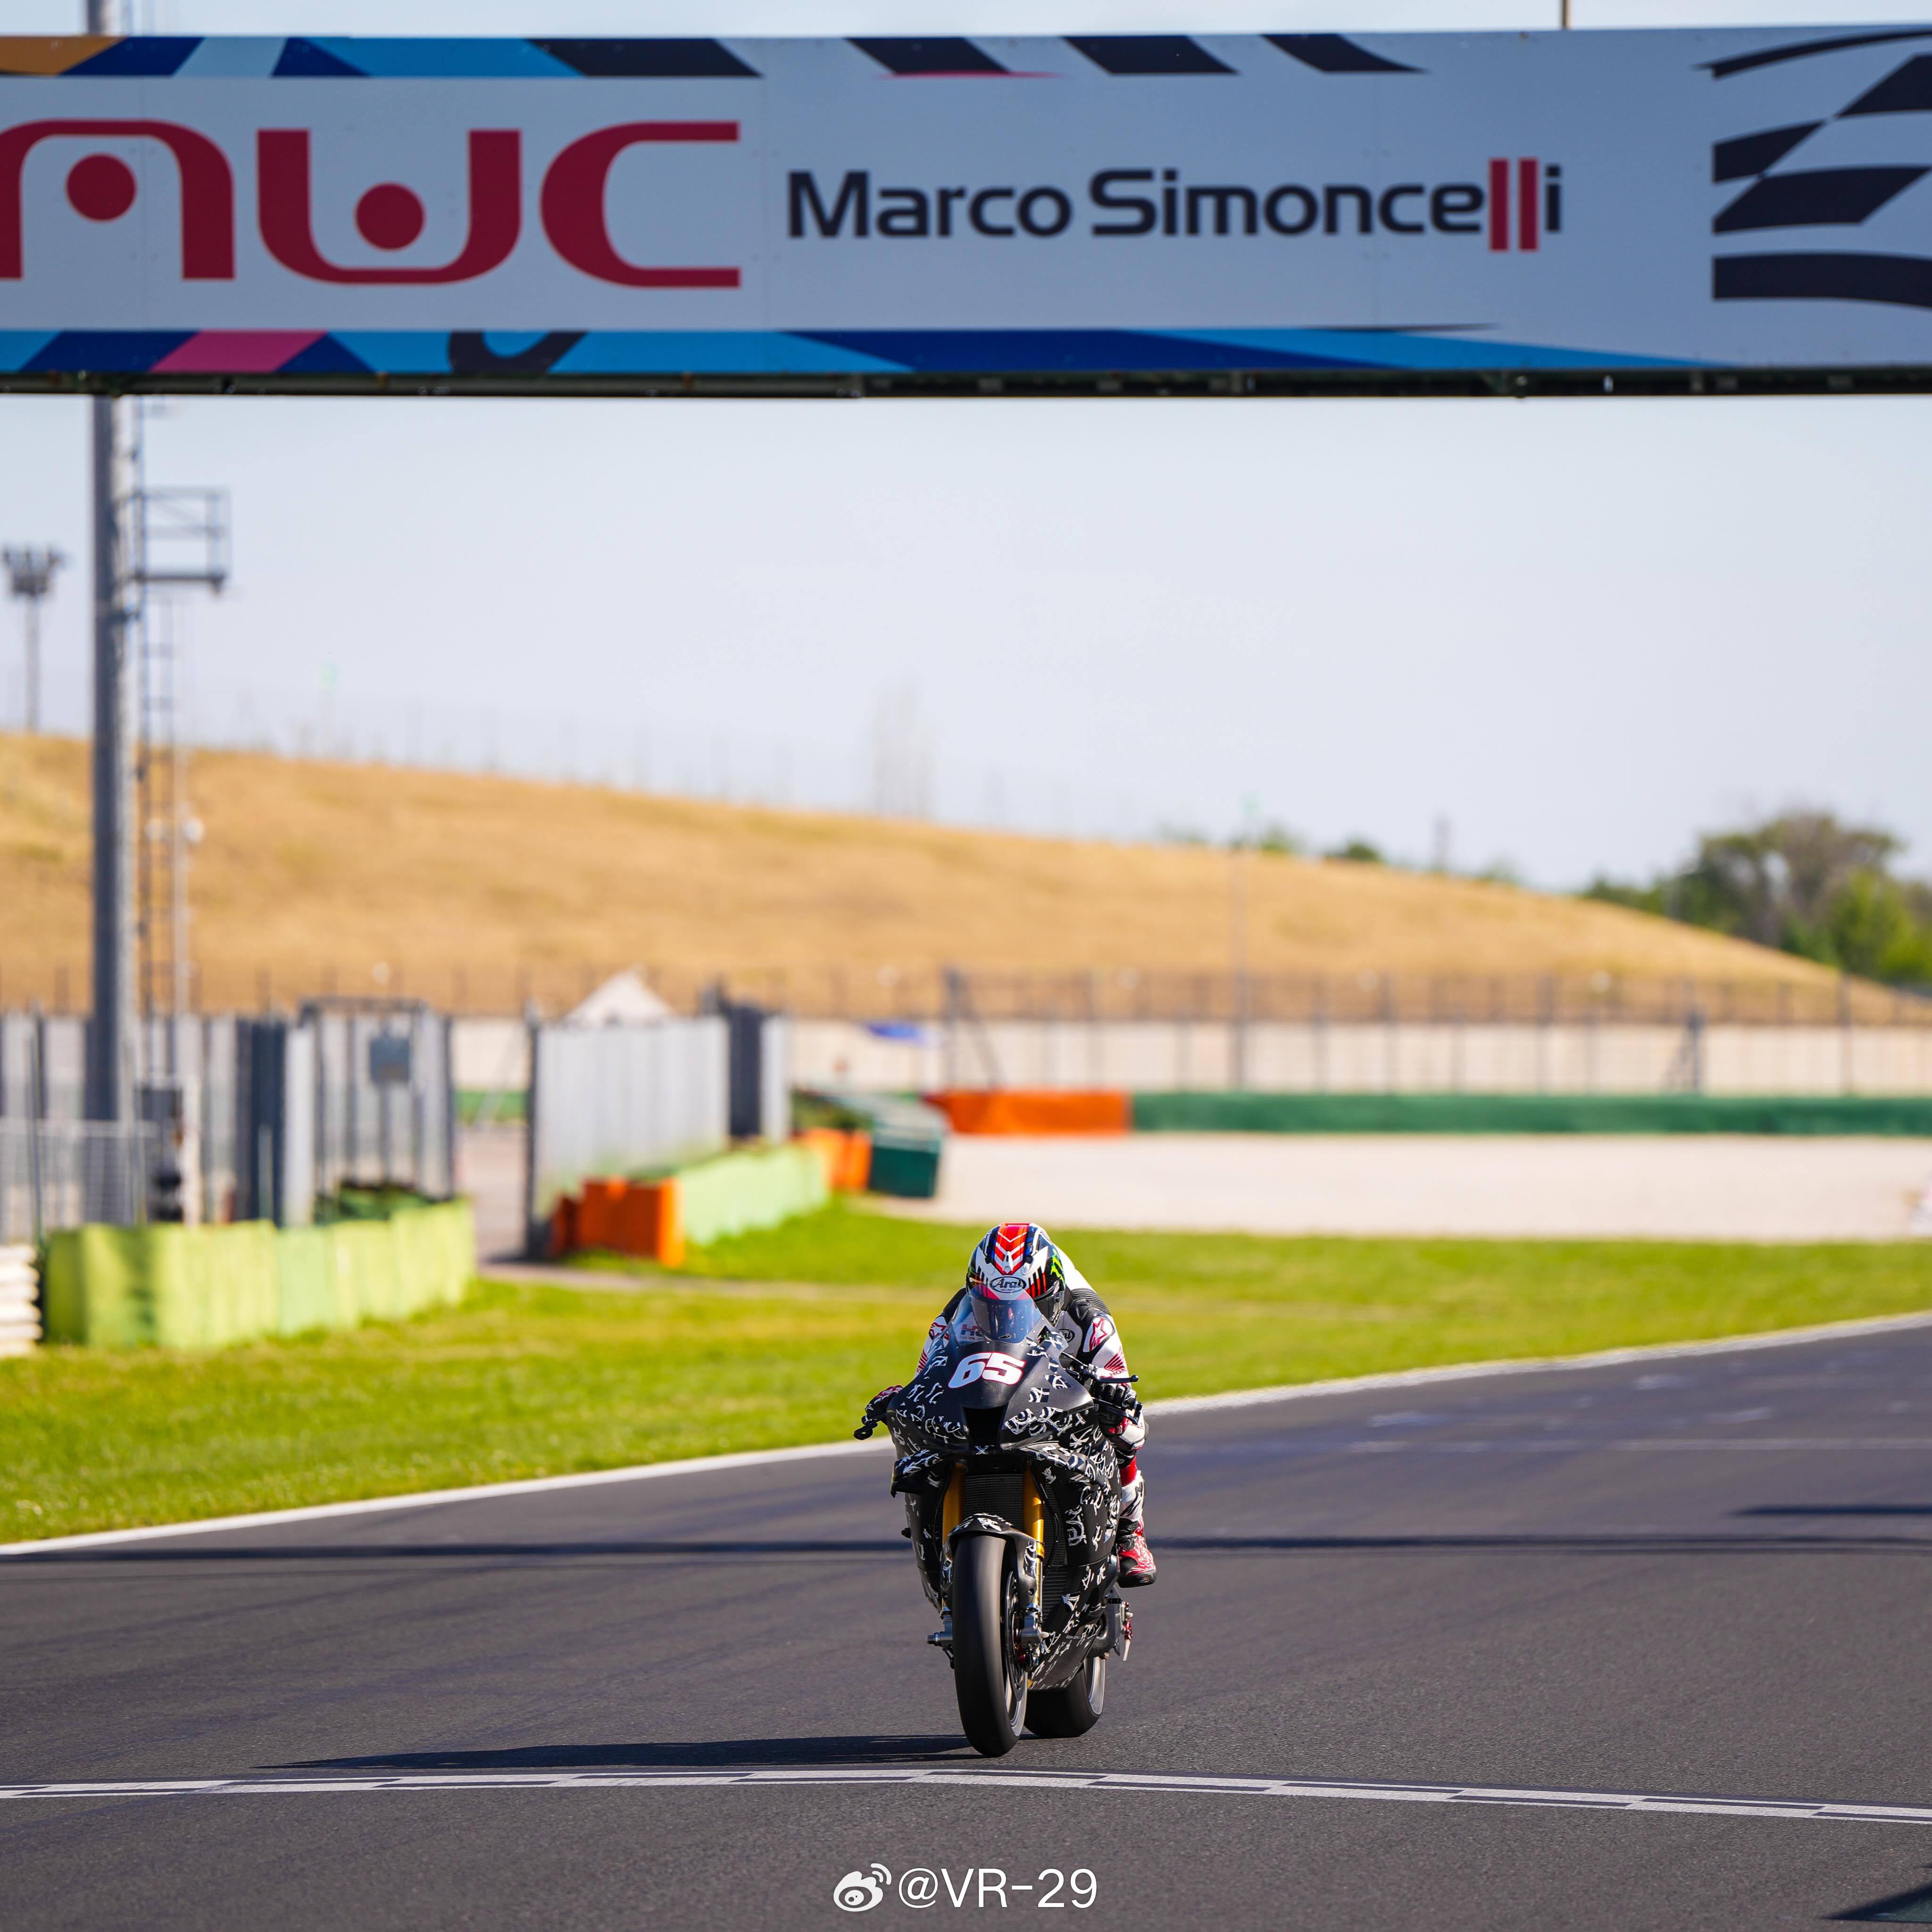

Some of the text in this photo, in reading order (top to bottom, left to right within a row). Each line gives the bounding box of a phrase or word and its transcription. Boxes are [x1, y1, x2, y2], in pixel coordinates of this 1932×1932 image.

[788, 158, 1562, 251] Marco Simoncelli
[991, 1278, 1023, 1289] Arai
[948, 1351, 1027, 1389] 65
